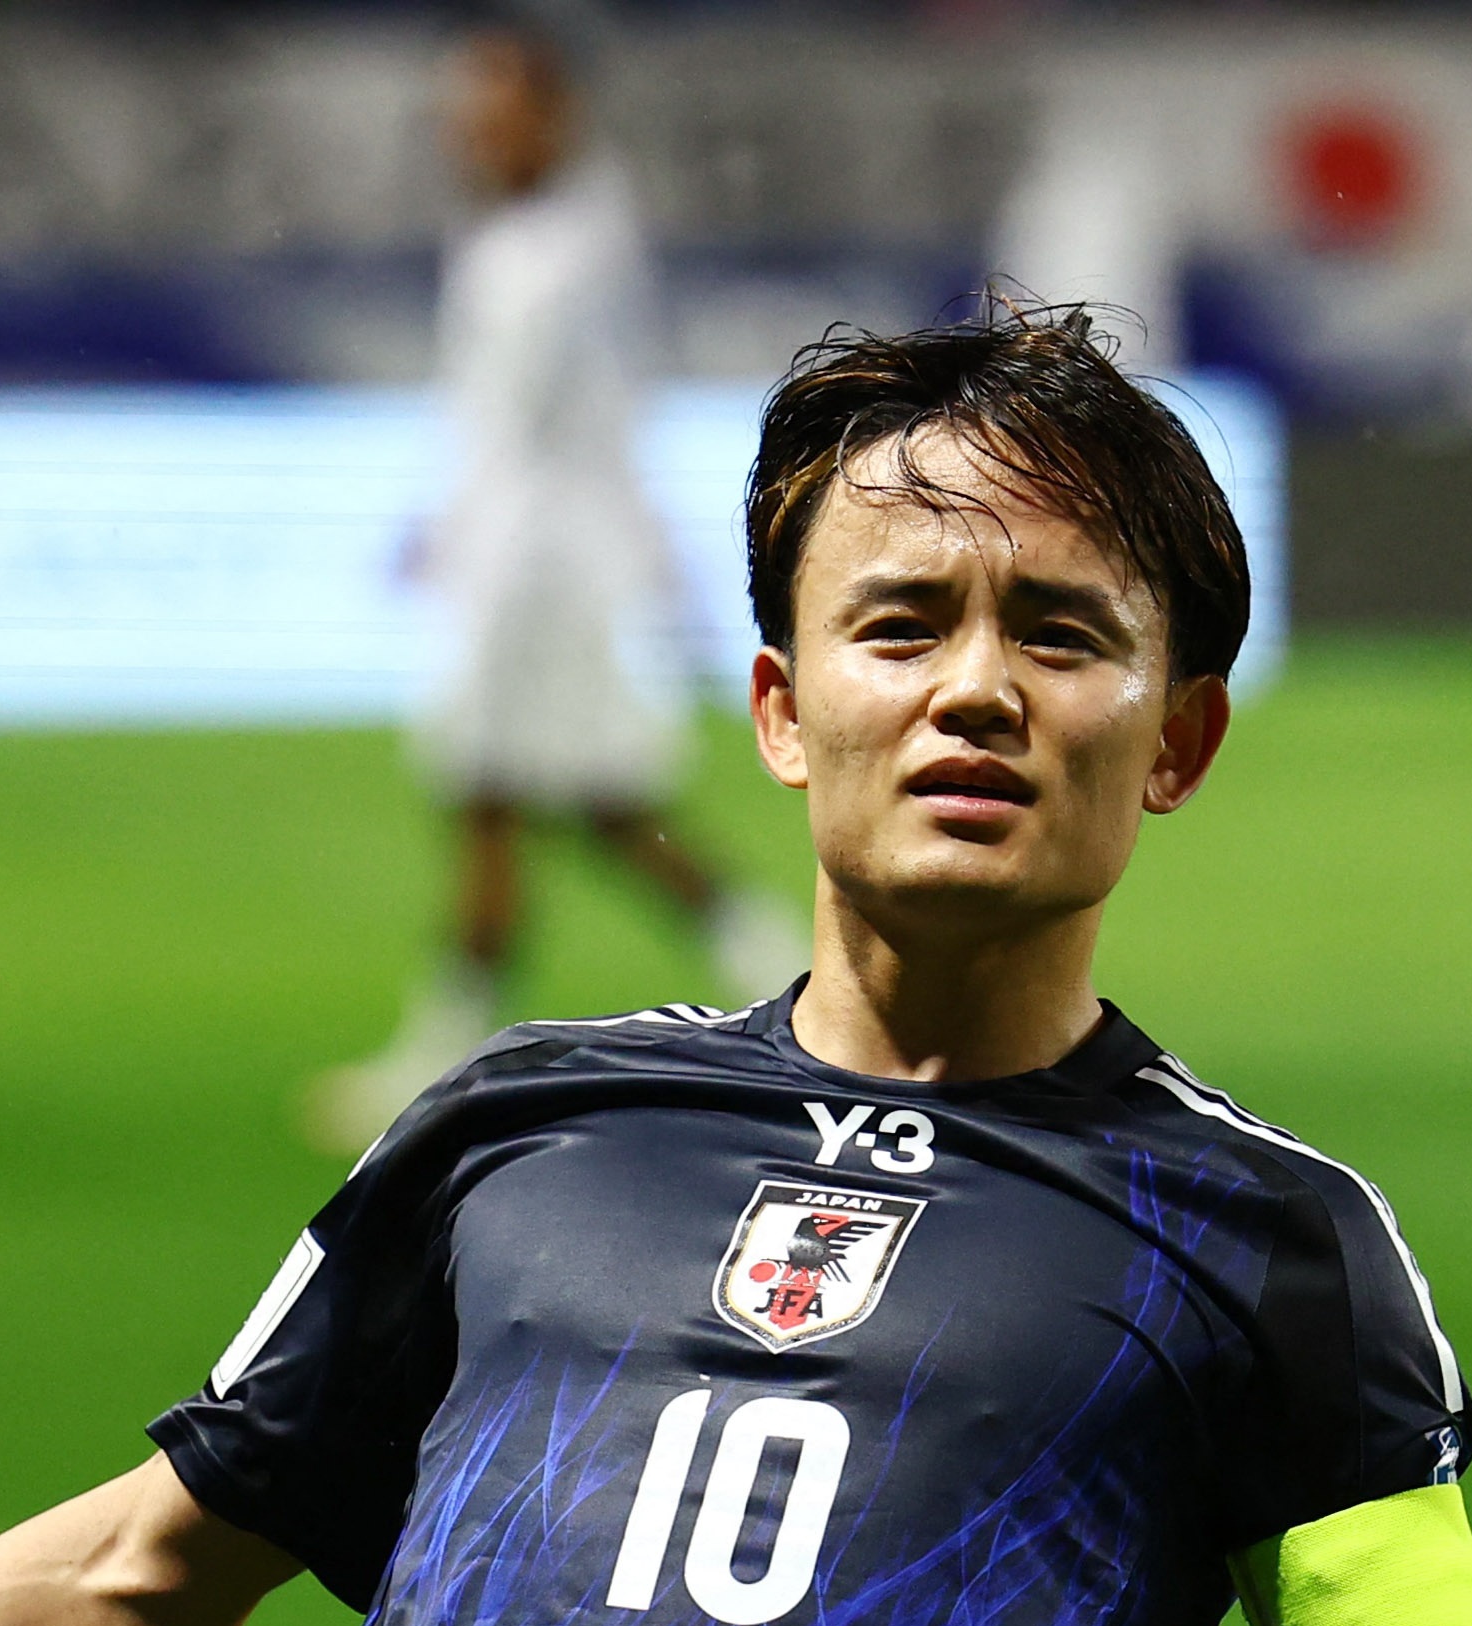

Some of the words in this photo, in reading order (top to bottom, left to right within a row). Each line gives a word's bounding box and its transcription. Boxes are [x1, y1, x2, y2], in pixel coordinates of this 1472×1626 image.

[801, 1101, 937, 1175] Y-3
[795, 1191, 883, 1213] JAPAN
[752, 1286, 824, 1320] JFA
[605, 1386, 852, 1626] 10
